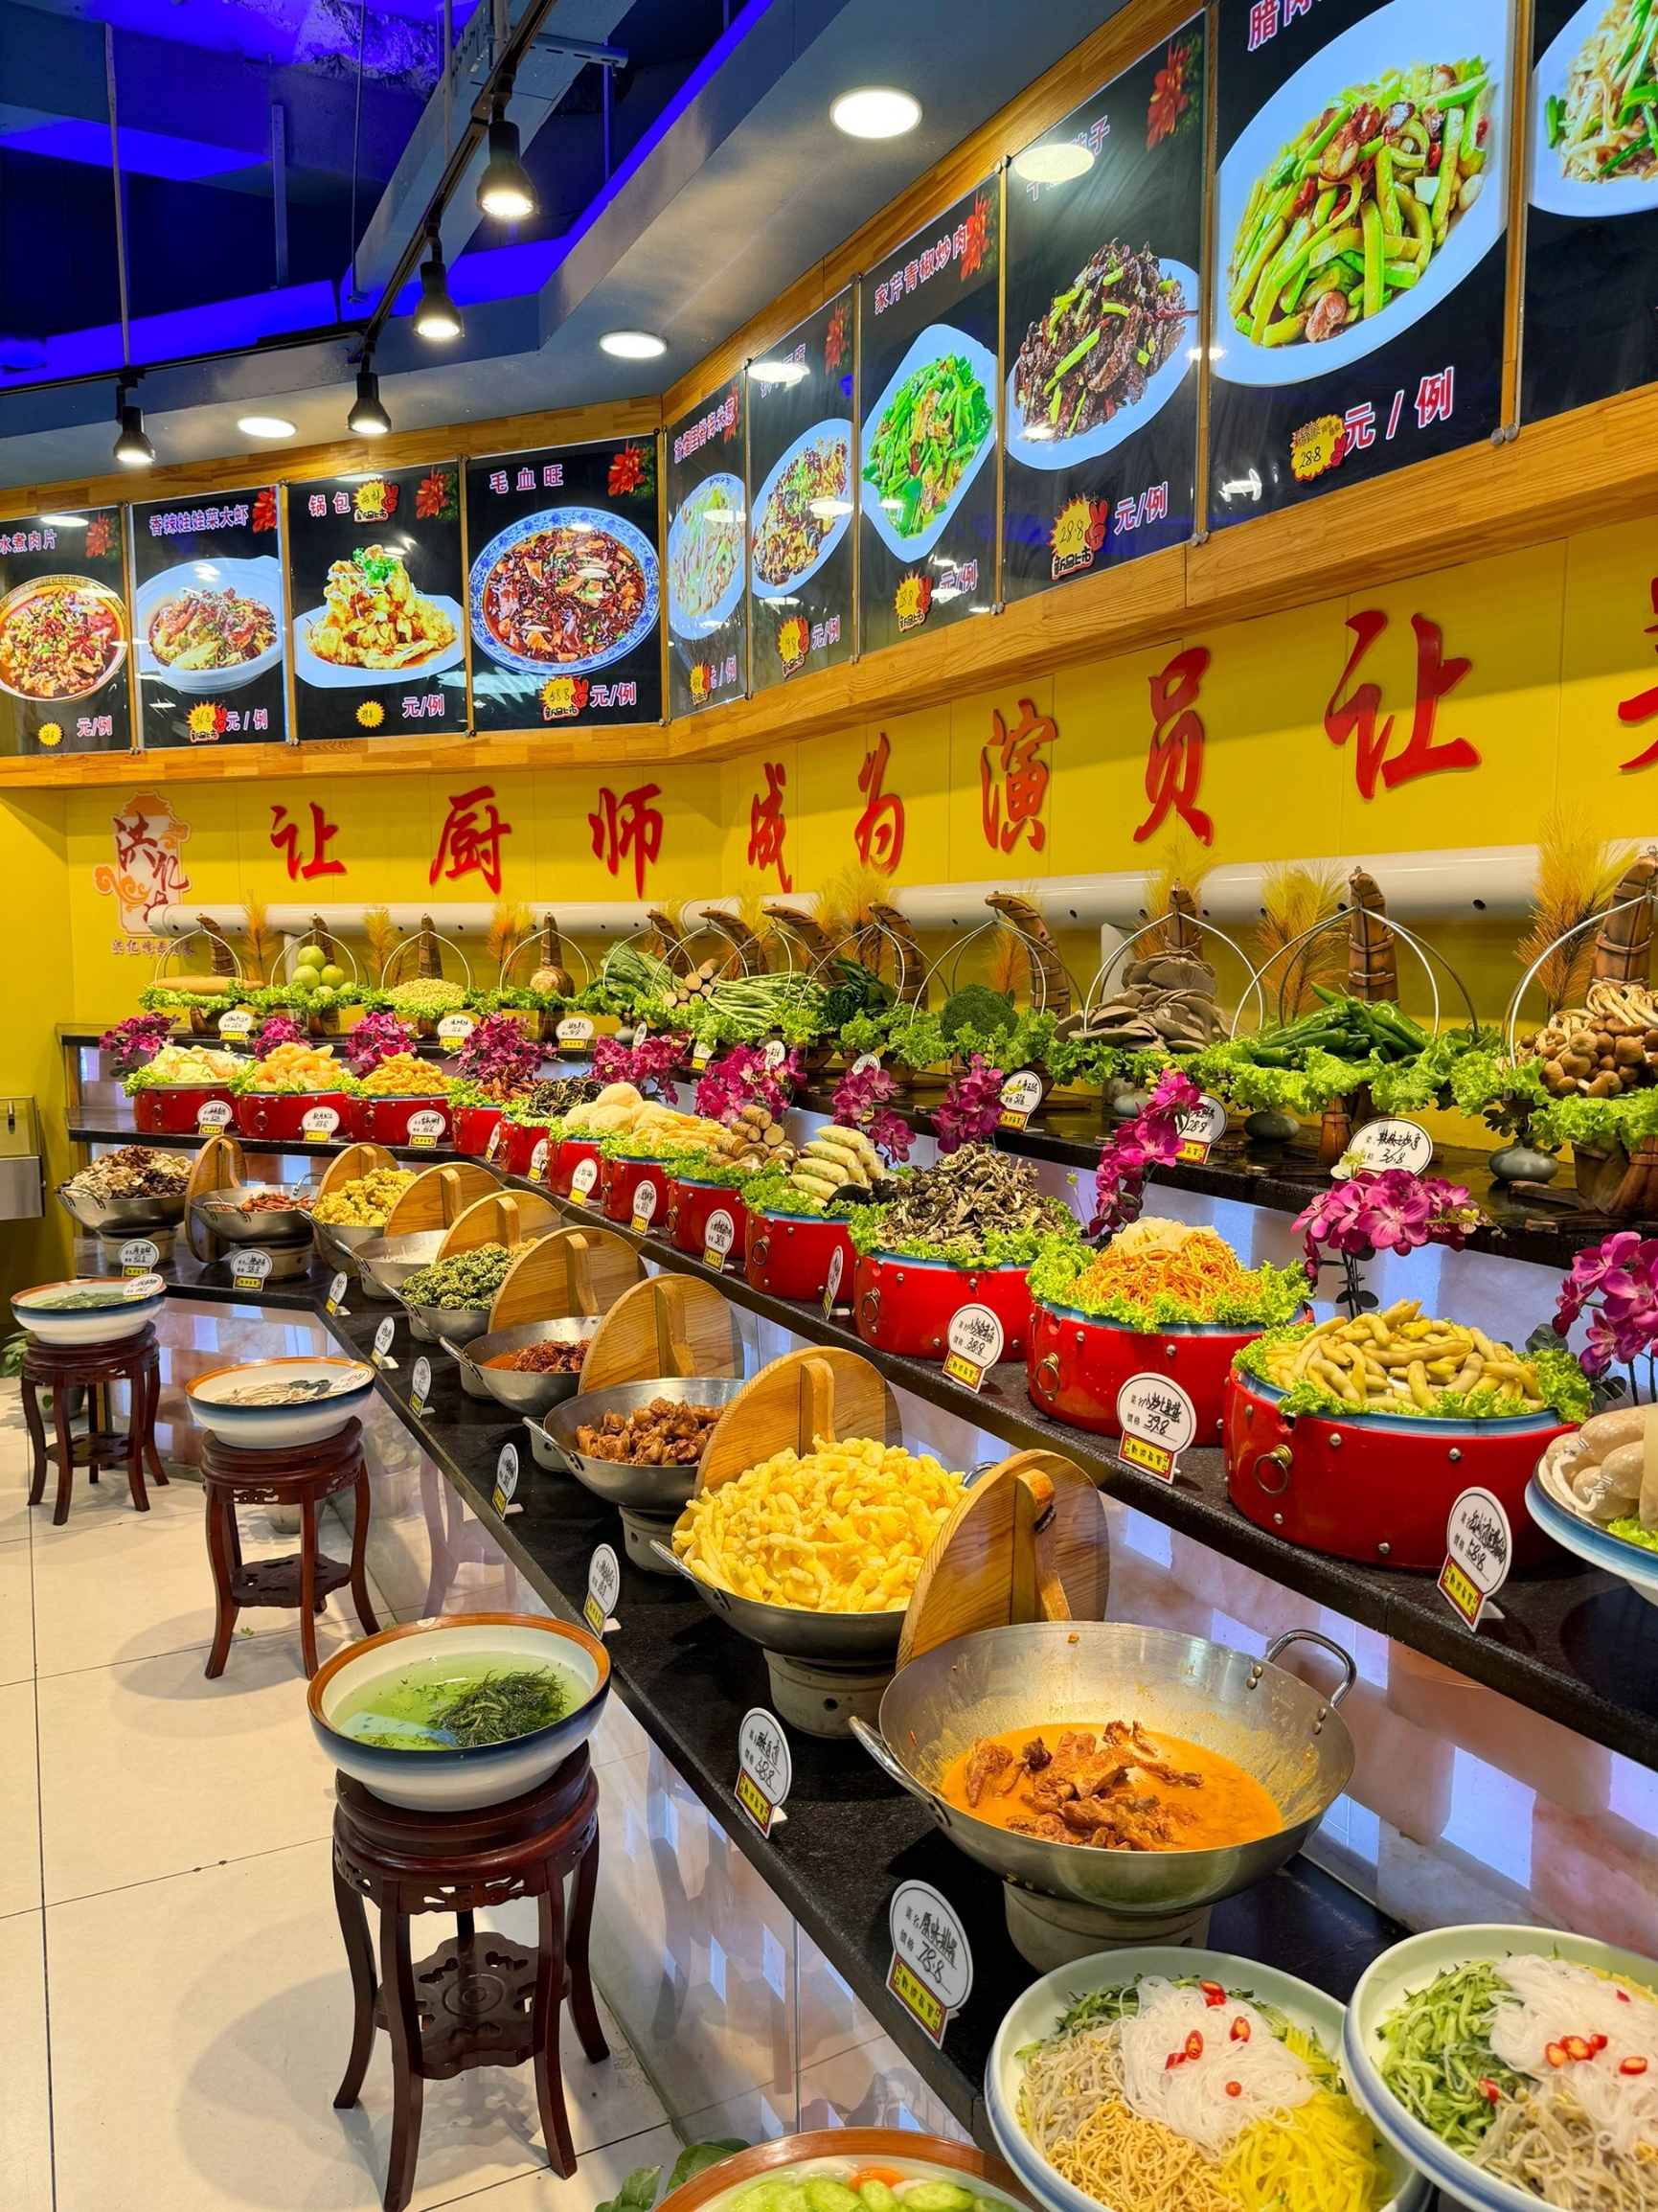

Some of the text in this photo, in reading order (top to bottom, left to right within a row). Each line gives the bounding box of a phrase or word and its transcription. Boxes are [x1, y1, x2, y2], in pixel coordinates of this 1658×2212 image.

[1299, 445, 1322, 469] 28.8
[489, 463, 564, 495] 毛血旺
[308, 490, 352, 517] 锅包
[1114, 480, 1170, 536] 元/例
[149, 503, 250, 537] 香辣娃娃菜大虾
[1059, 519, 1084, 544] 28.8
[0, 529, 57, 556] 水煮肉片
[1053, 545, 1092, 576] 新品上市
[811, 613, 840, 651] 元/例
[402, 694, 445, 718] 元/例
[589, 681, 638, 708] 元/例
[544, 704, 579, 718] 新品上市
[76, 715, 113, 738] 元/例
